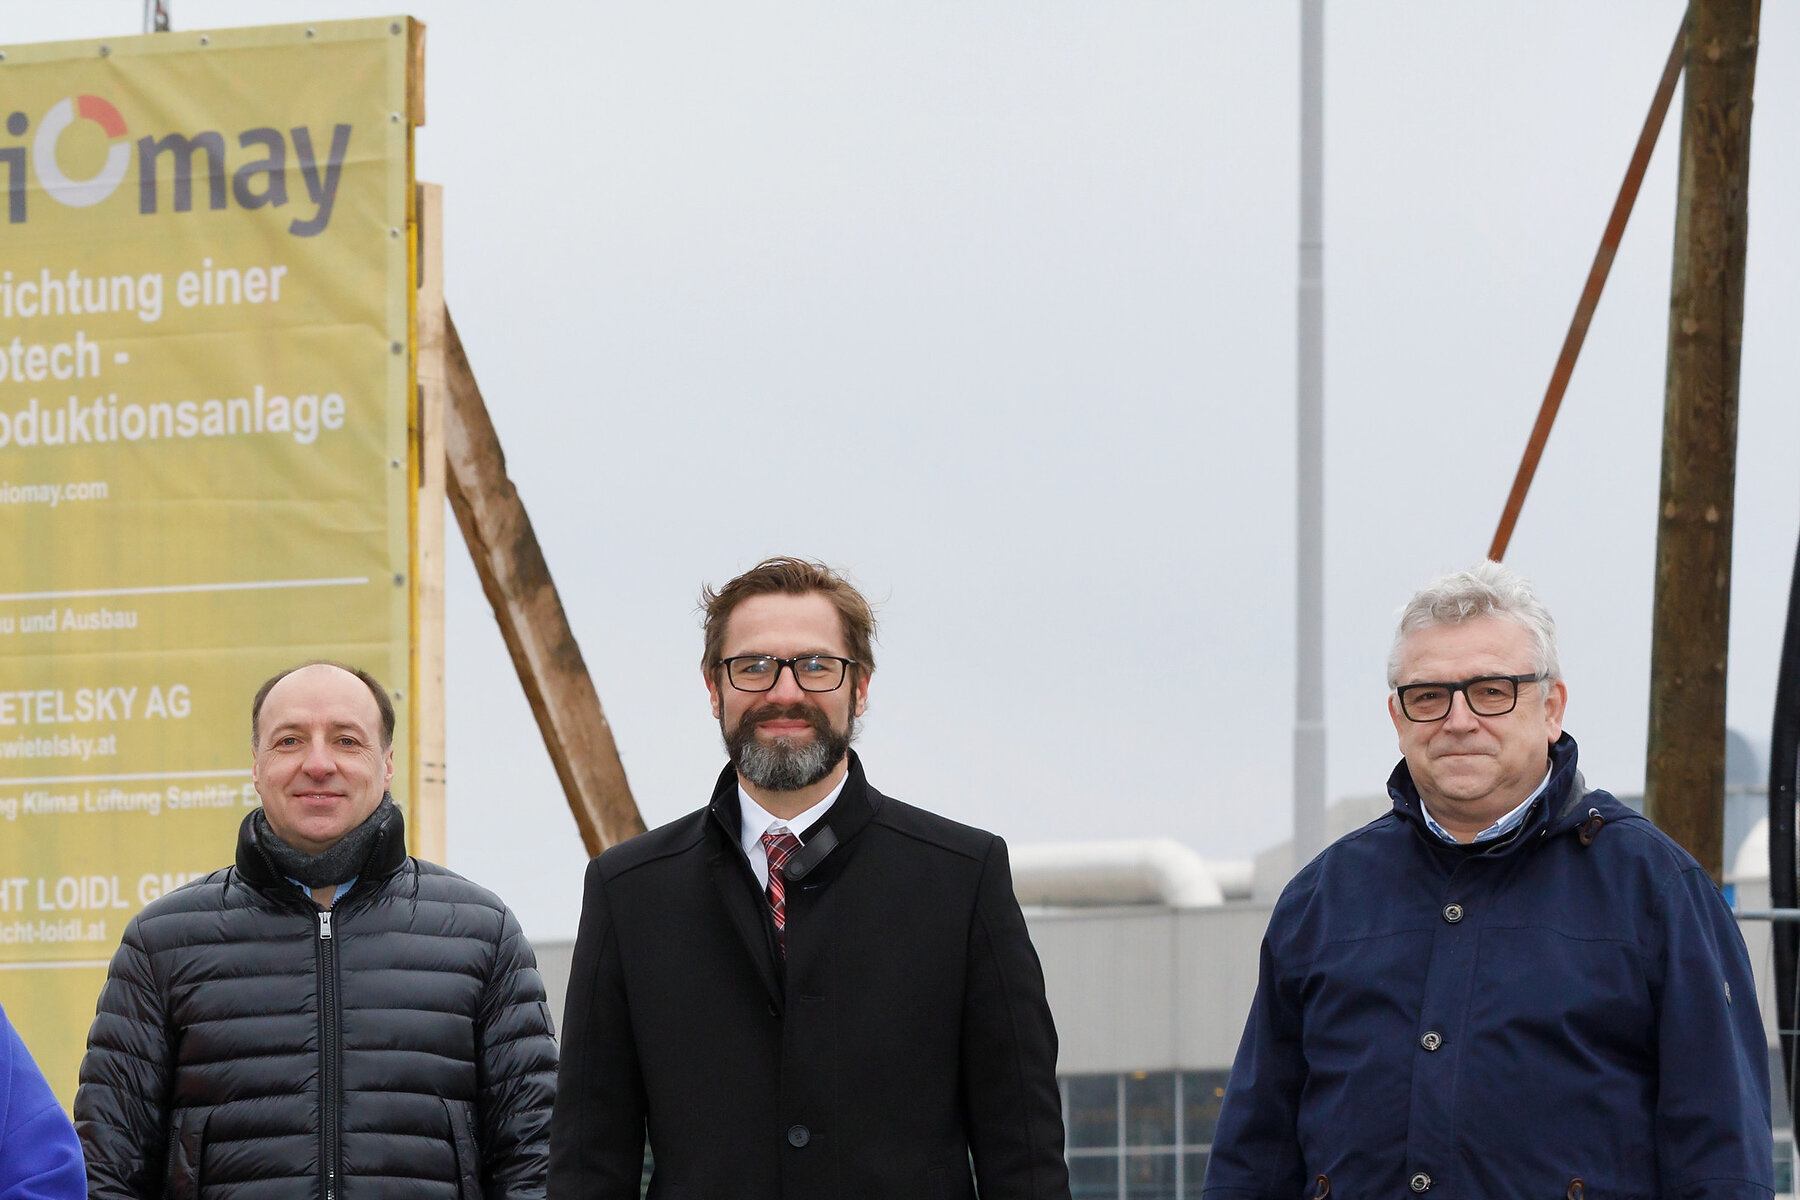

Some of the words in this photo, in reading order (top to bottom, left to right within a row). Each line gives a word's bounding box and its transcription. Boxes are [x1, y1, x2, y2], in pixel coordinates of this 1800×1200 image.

[176, 258, 288, 302] einer
[19, 609, 57, 633] und
[61, 607, 139, 632] Ausbau
[145, 684, 191, 720] AG
[22, 790, 79, 815] Klima
[84, 788, 162, 816] Lüftung
[166, 783, 238, 810] Sanitär
[37, 874, 130, 912] LOIDL
